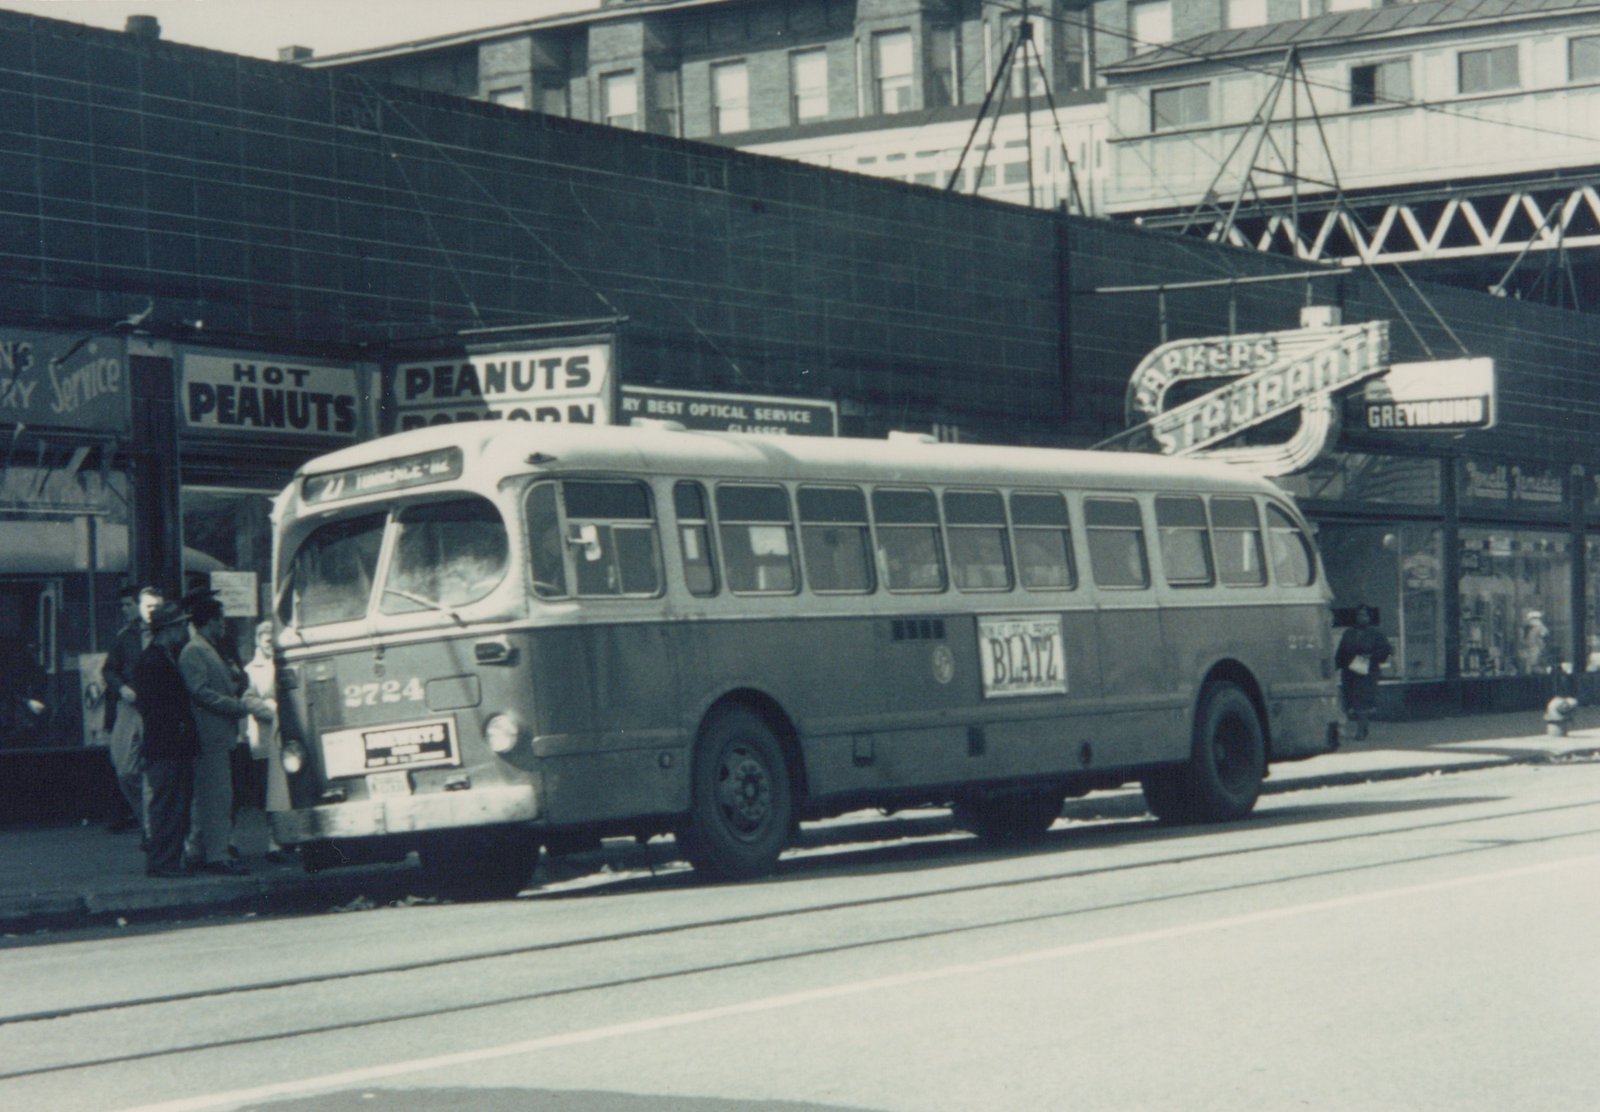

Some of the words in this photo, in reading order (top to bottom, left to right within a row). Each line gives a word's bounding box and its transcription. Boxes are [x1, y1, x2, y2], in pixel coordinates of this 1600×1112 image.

[48, 343, 121, 413] Service
[233, 362, 310, 387] HOT
[404, 355, 591, 401] PEANUTS
[187, 382, 356, 432] PEANUTS
[647, 399, 683, 414] BEST
[689, 403, 747, 419] OPTICAL
[753, 408, 811, 423] SERVICE
[1368, 398, 1482, 428] GREYHOUND
[989, 632, 1057, 685] BLATZ
[344, 677, 425, 708] 2724
